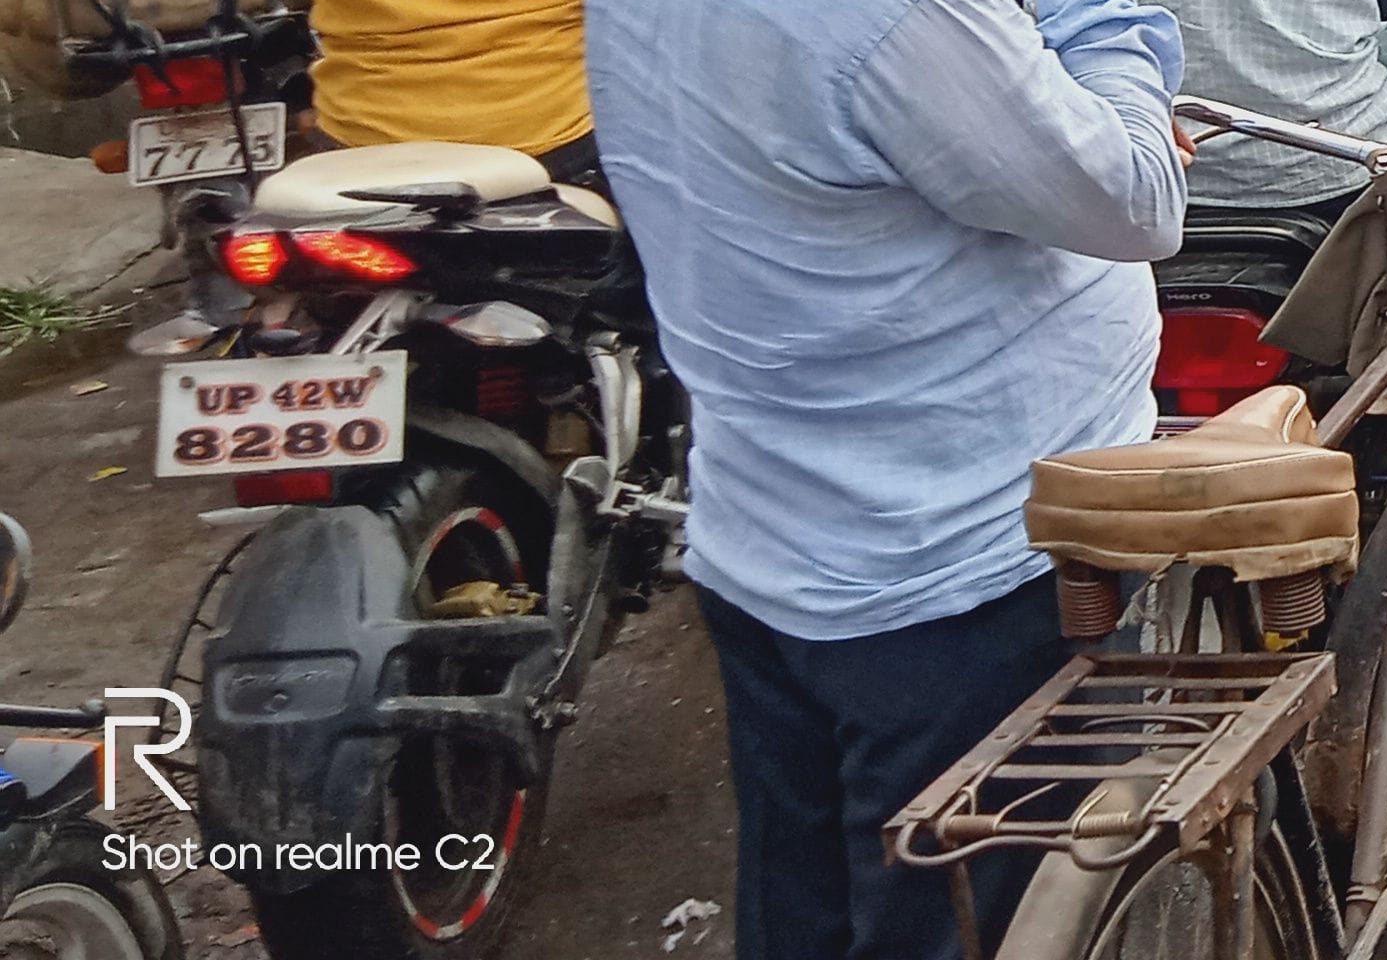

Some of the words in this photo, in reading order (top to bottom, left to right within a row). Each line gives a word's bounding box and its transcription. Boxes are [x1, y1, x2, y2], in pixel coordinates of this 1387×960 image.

[197, 383, 263, 416] UP
[271, 374, 379, 411] 42W
[174, 416, 390, 466] 8280
